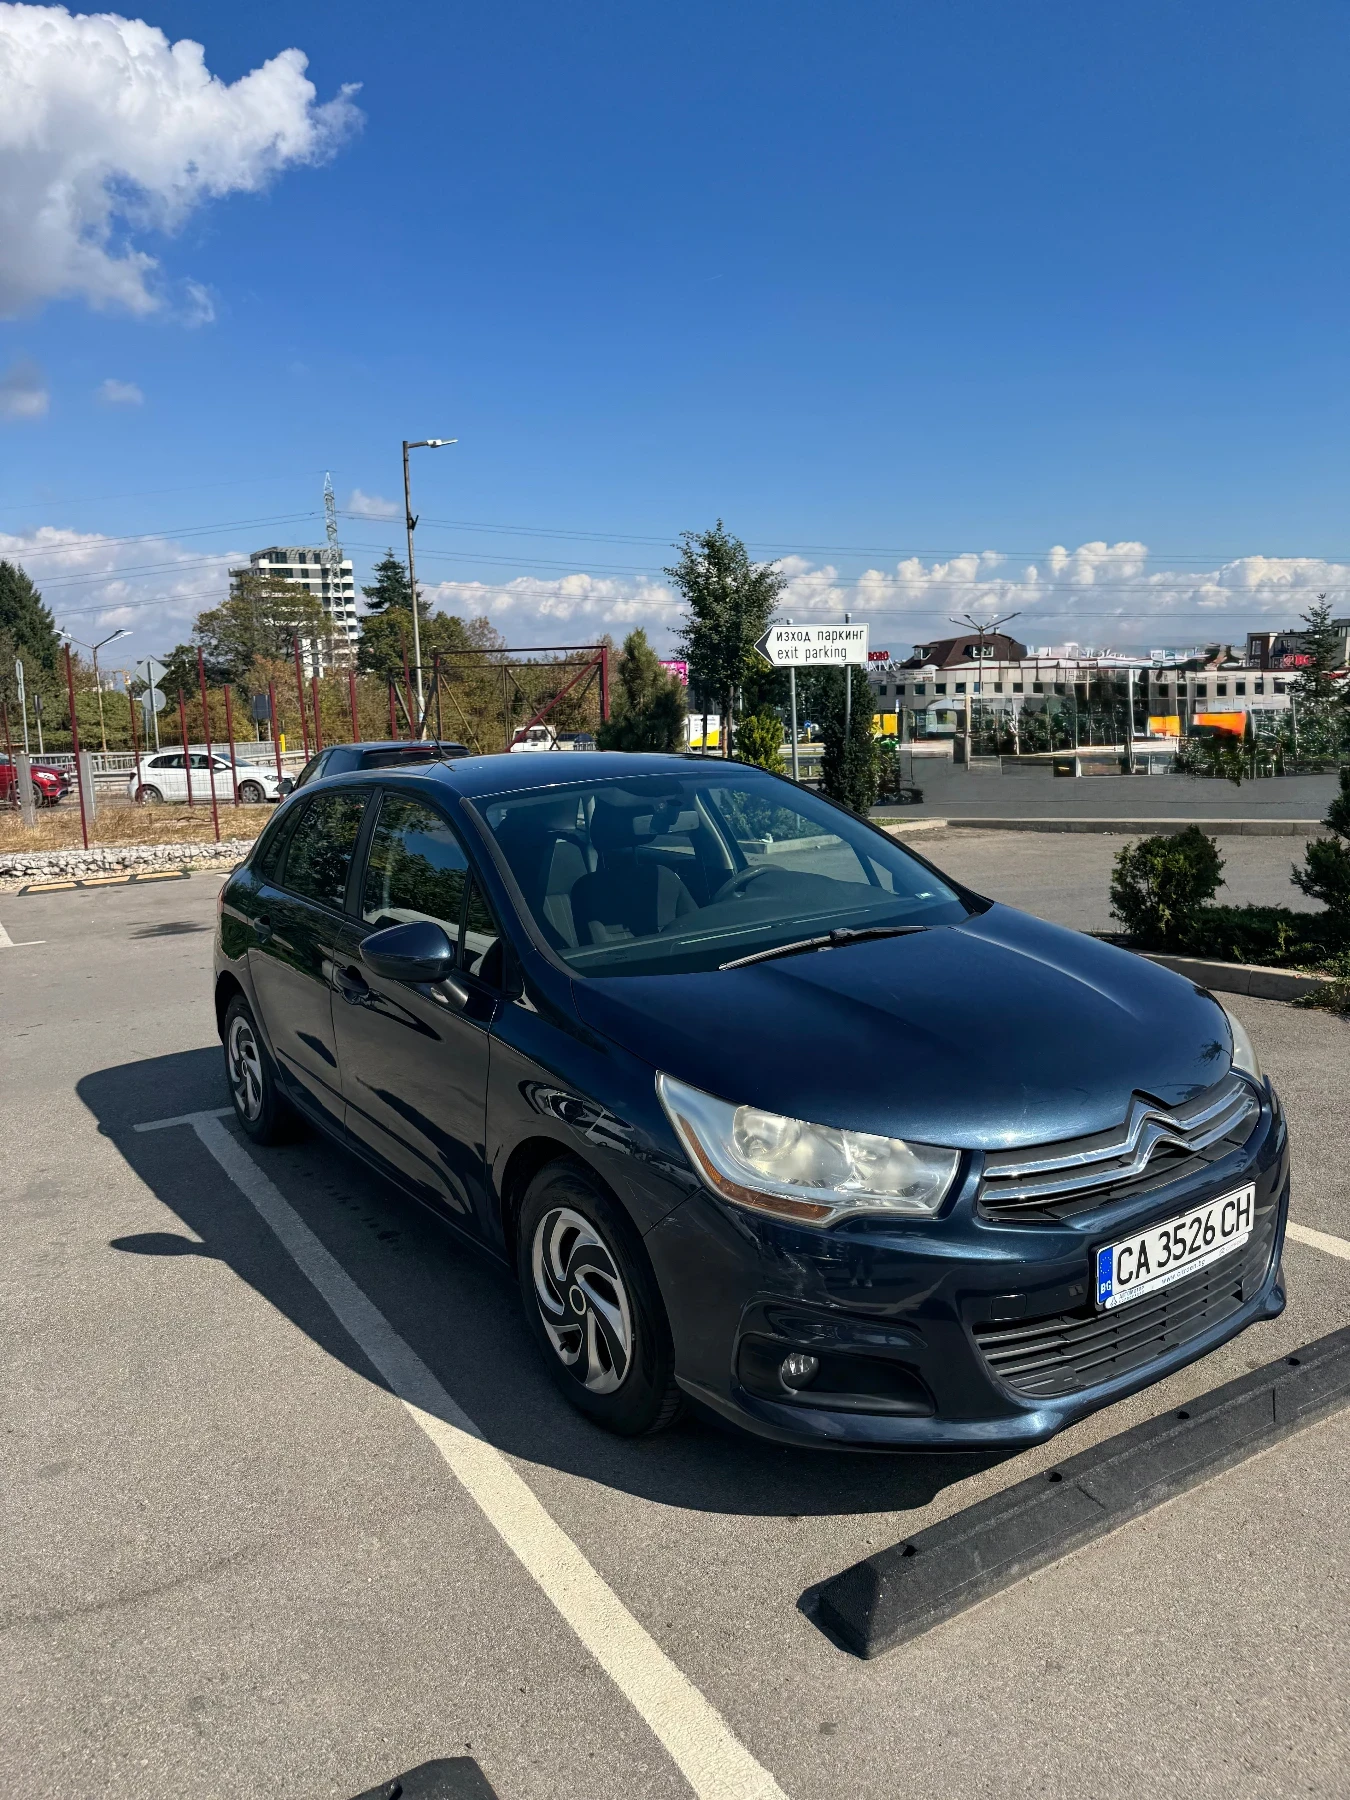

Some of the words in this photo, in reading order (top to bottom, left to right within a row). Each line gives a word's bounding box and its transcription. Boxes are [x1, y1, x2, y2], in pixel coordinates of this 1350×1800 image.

[776, 631, 811, 643] изход
[817, 630, 864, 643] паркинг
[777, 646, 799, 659] exit
[805, 645, 847, 661] parking
[1116, 1240, 1151, 1285] CA
[1157, 1210, 1216, 1268] 3526
[1221, 1193, 1251, 1238] CH
[1100, 1280, 1112, 1295] BG
